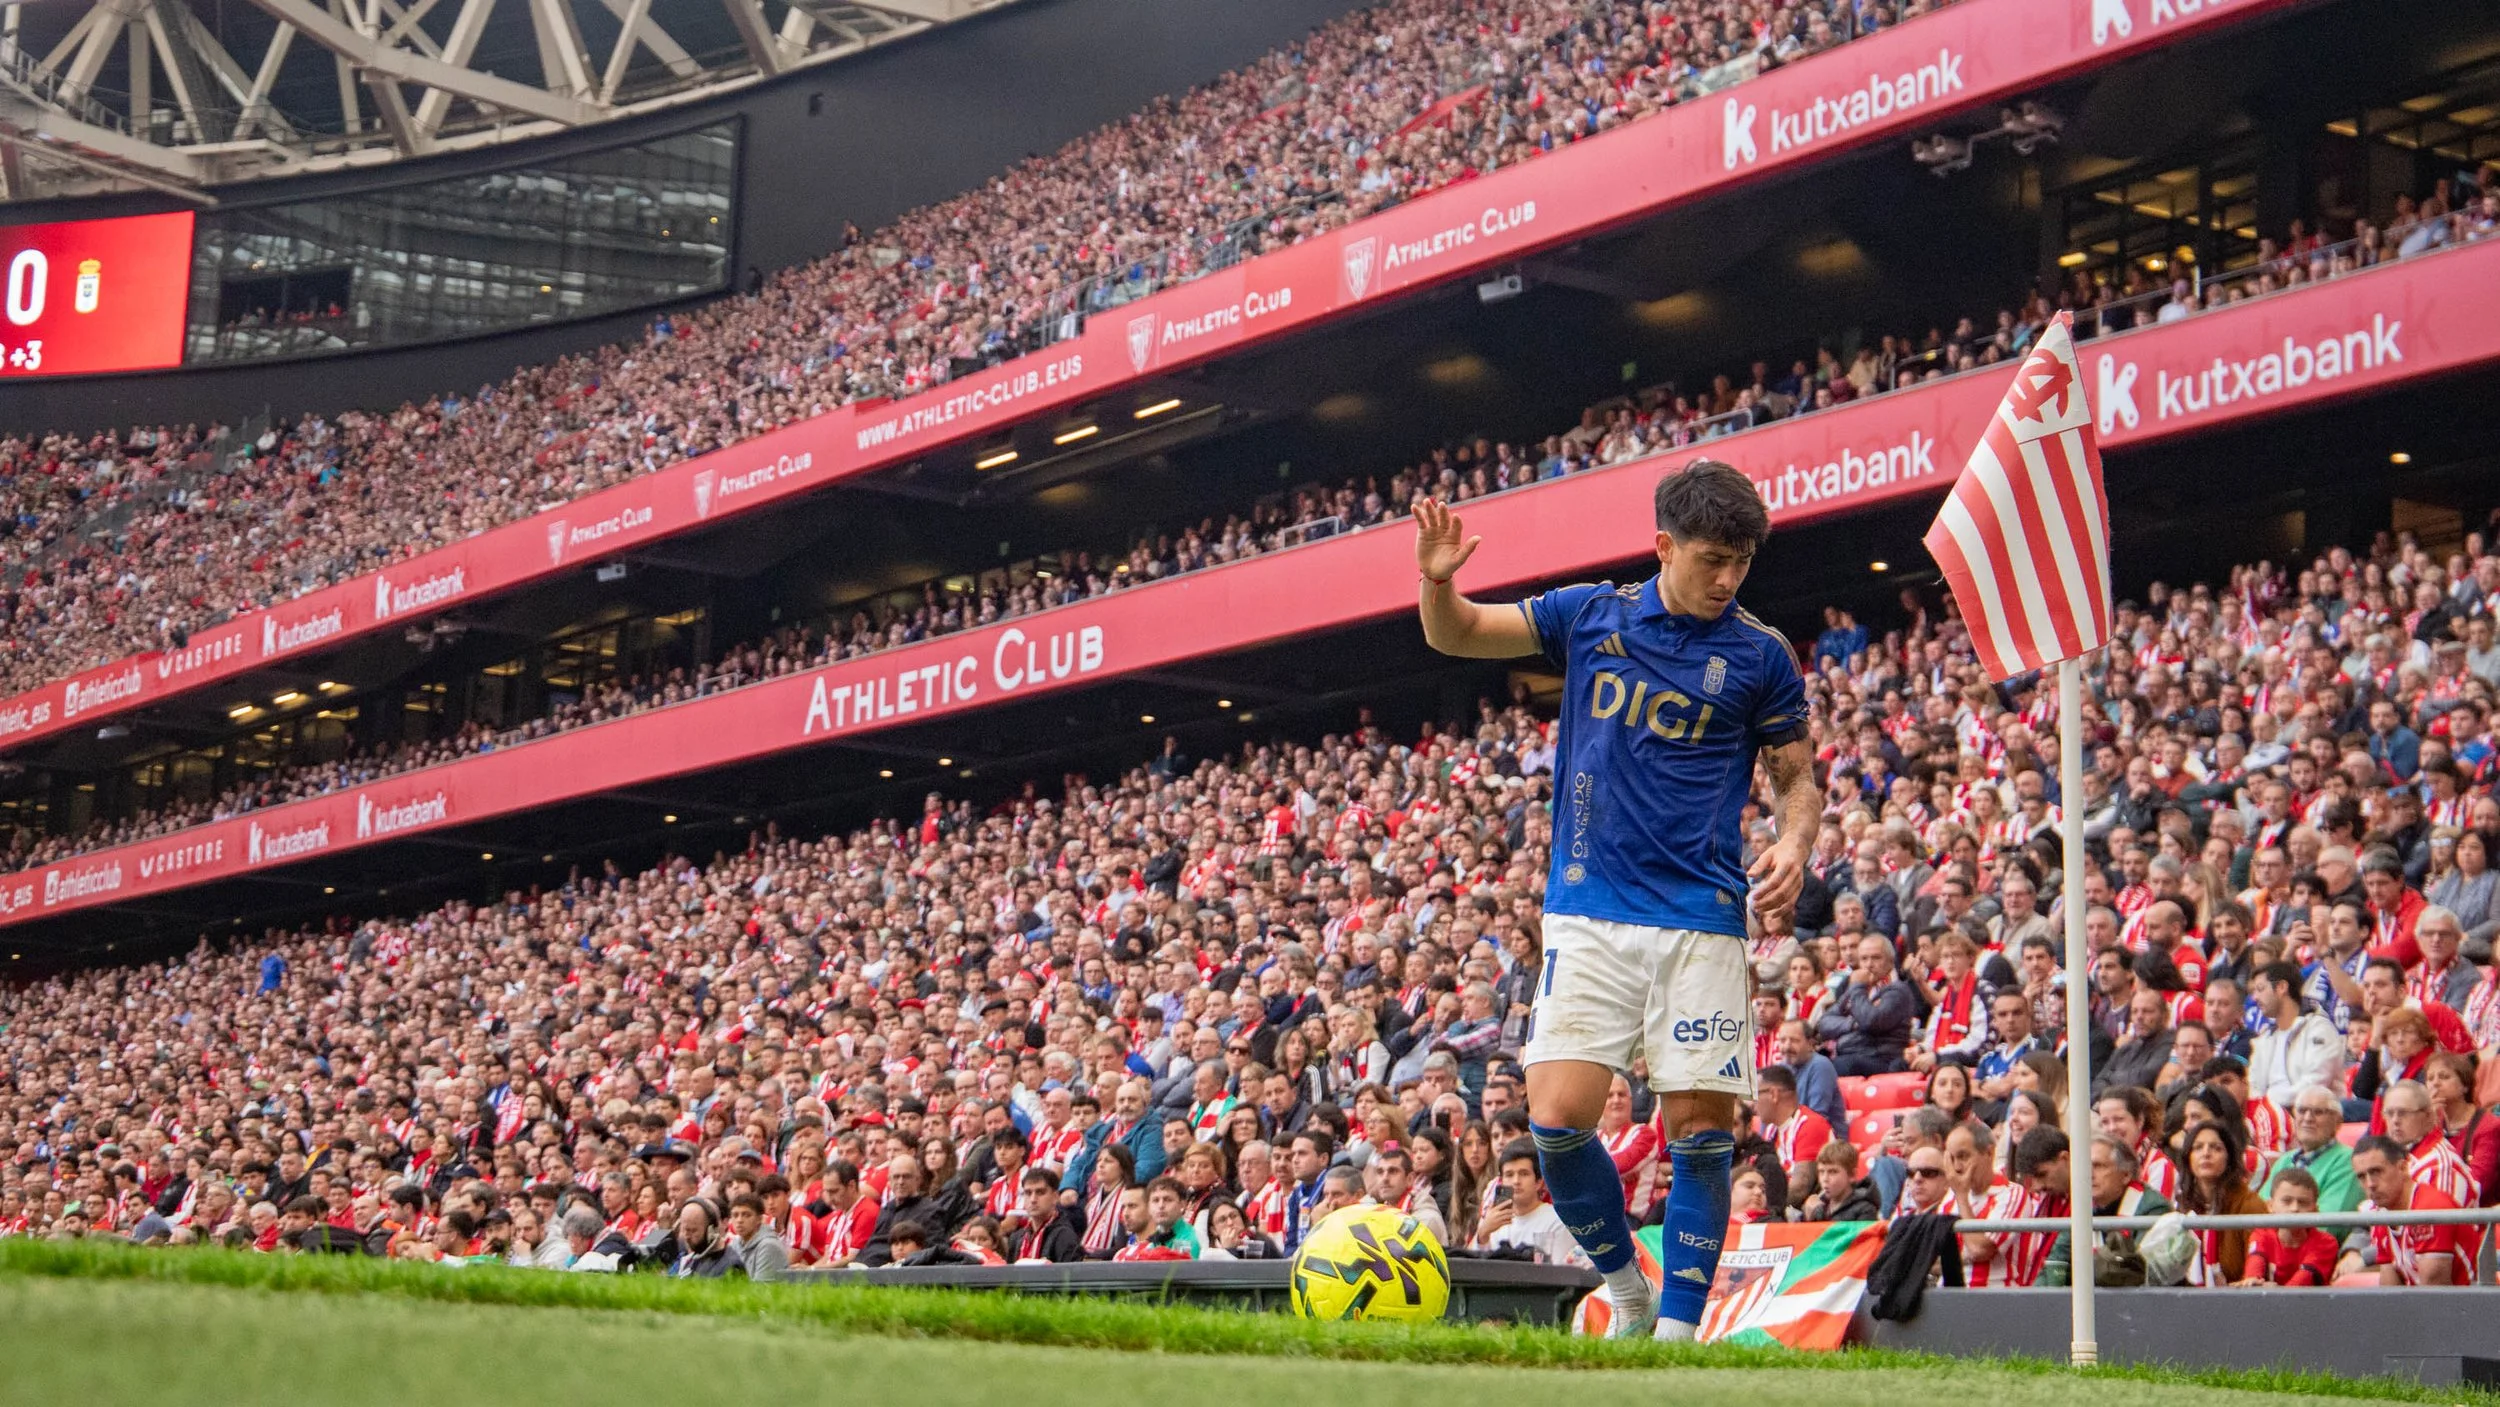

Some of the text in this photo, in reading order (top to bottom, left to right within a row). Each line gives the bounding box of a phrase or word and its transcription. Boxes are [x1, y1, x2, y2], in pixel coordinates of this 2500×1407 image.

[1771, 48, 1963, 153] kutxabank
[7, 249, 48, 326] 0
[2158, 313, 2403, 420] kutxabank
[857, 355, 1083, 450] WWW.ATHLETIC-CLUB.EUS
[393, 566, 465, 615] kutxabank
[175, 632, 243, 673] CASTORE
[1591, 671, 1715, 746] DIGI
[375, 791, 447, 834] kutxabank
[157, 839, 222, 878] CASTORE
[1673, 1010, 1745, 1043] esfer
[1678, 1231, 1720, 1251] 1926
[1759, 1250, 1790, 1265] CLUB
